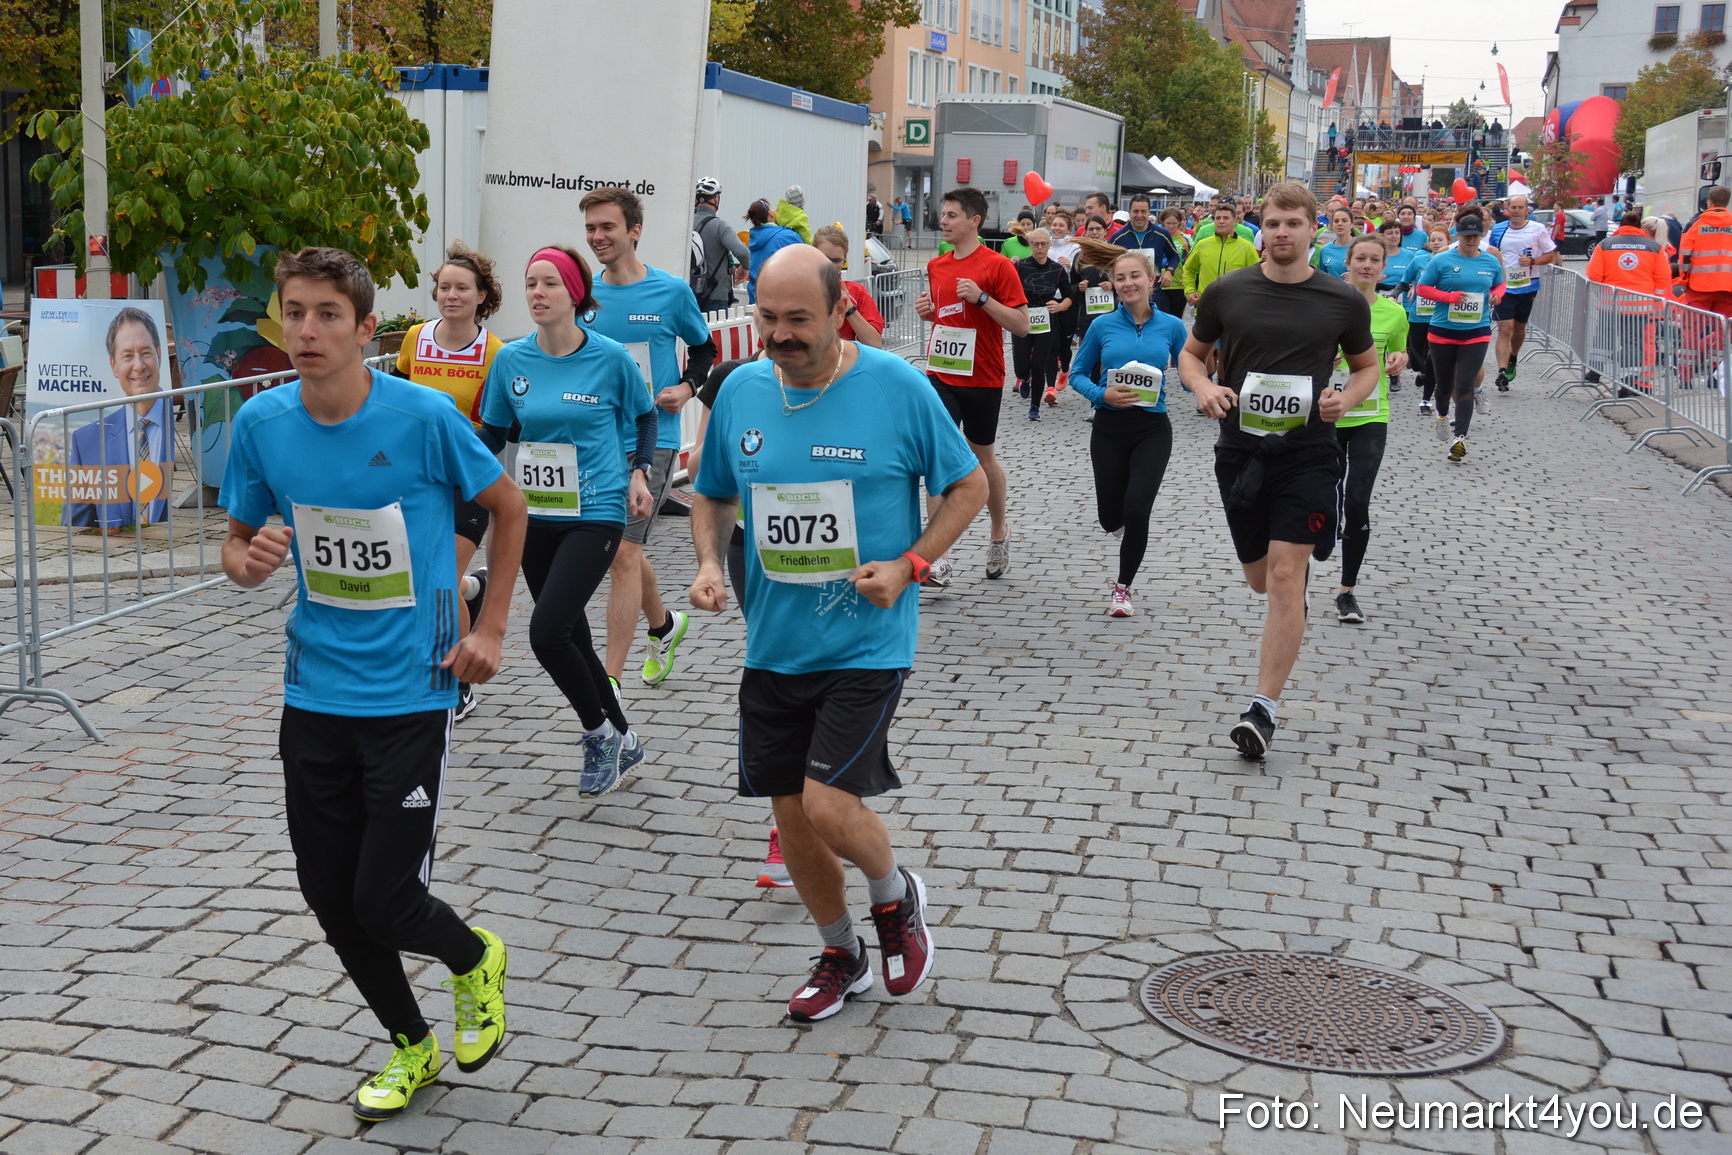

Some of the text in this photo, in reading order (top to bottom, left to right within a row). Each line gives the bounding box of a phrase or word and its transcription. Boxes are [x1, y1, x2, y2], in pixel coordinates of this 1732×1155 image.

[910, 123, 927, 141] D
[1400, 154, 1424, 163] ZIEL
[485, 170, 655, 196] www.bmw-laufsport.de
[1701, 226, 1732, 234] NOTAR
[1089, 294, 1109, 304] 5110
[1420, 297, 1436, 306] 502
[1454, 302, 1479, 312] 5068
[628, 314, 661, 322] BOCK
[1030, 314, 1046, 324] 052
[934, 339, 967, 356] 5107
[38, 364, 92, 378] WEITER.
[413, 366, 483, 380] MAX BÖGL
[38, 379, 107, 393] MACHEN.
[1115, 372, 1153, 388] 5086
[562, 392, 599, 404] BOCK
[1249, 393, 1300, 415] 5046
[1261, 419, 1284, 428] Florian
[811, 445, 865, 460] BOCK
[739, 460, 759, 468] PARTL
[37, 468, 118, 485] THOMAS
[523, 464, 565, 488] 5131
[528, 493, 563, 504] Magdalena
[786, 492, 820, 502] BOCK
[334, 516, 371, 528] BOCK
[767, 513, 839, 545] 5073
[314, 535, 392, 572] 5135
[779, 555, 831, 567] Friedhelm
[339, 579, 371, 593] David
[402, 799, 431, 808] adidas
